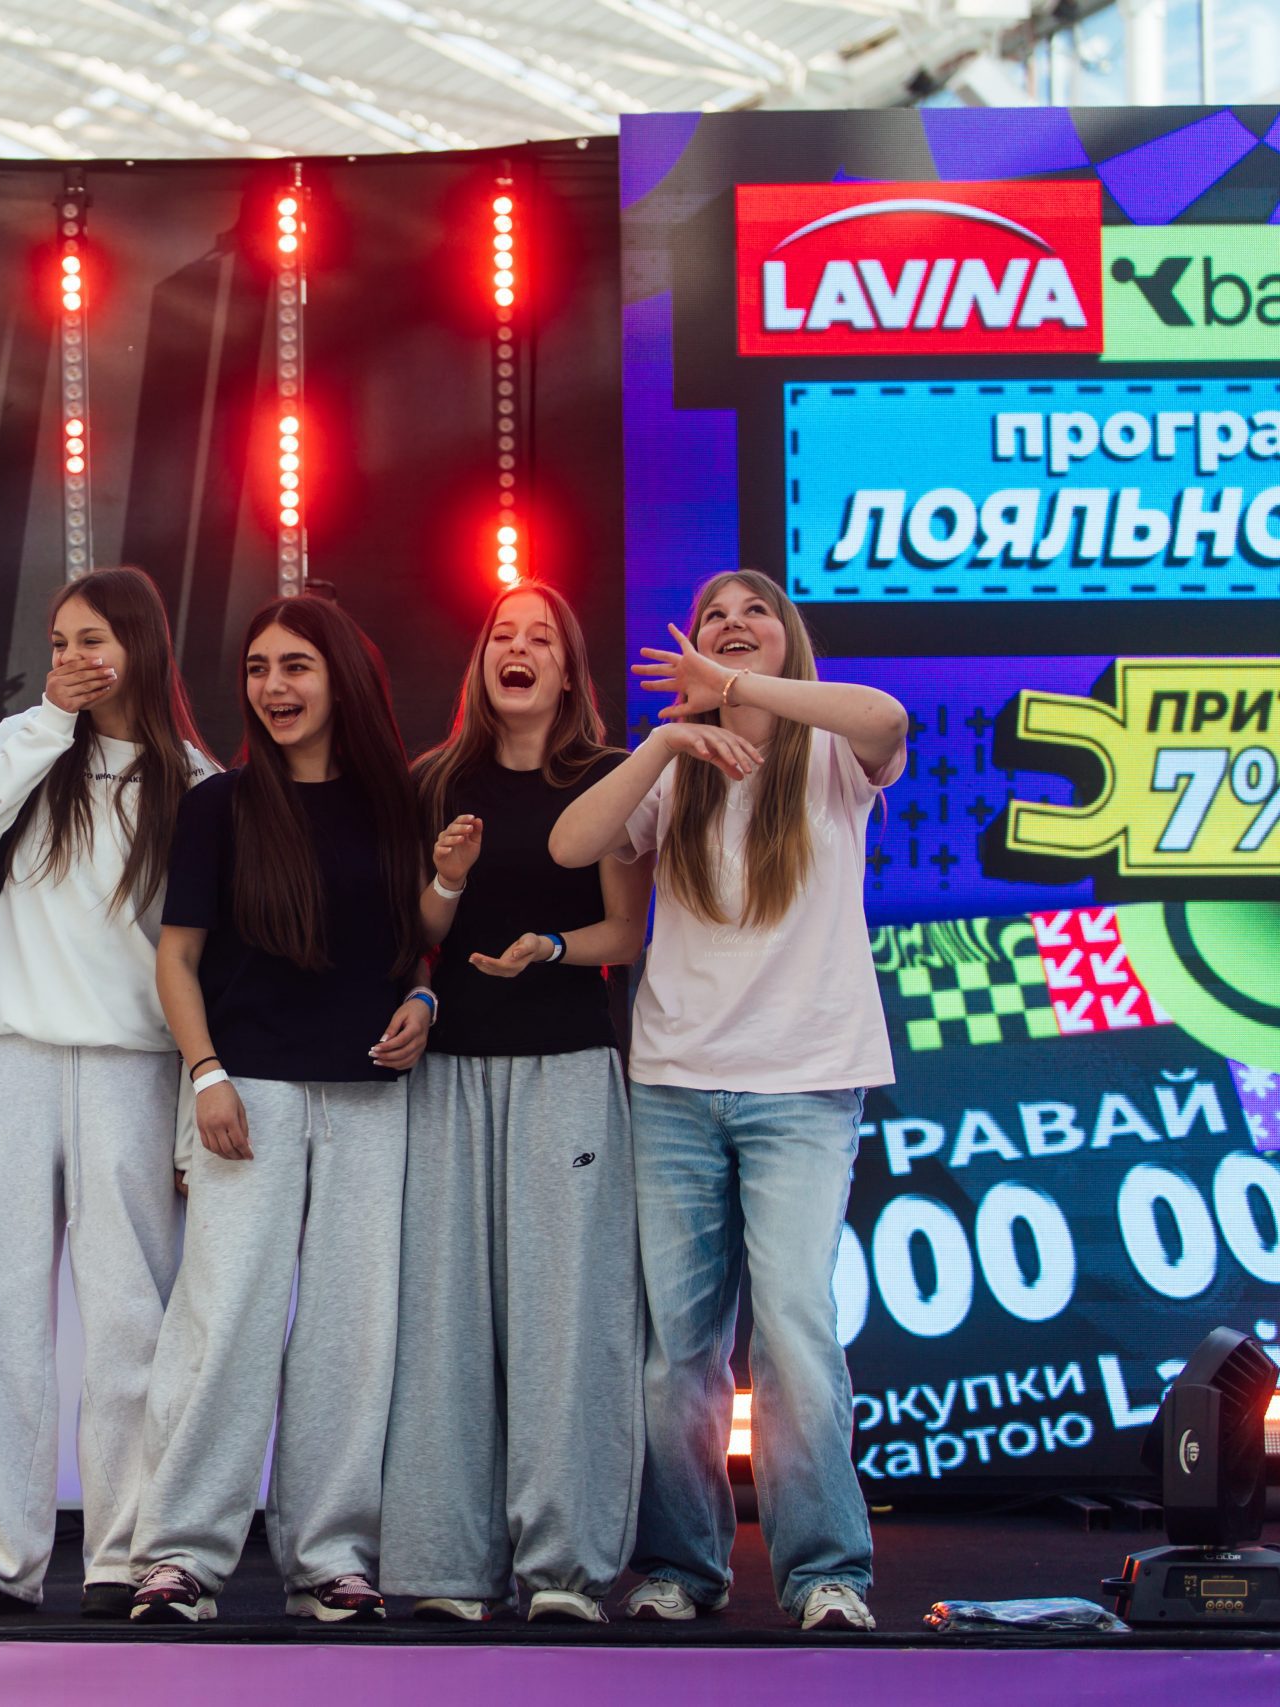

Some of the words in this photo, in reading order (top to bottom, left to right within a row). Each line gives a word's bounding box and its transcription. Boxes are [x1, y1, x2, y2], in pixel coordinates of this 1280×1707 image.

[761, 257, 1089, 331] LAVINA
[1147, 690, 1280, 733] ПРИ
[95, 772, 117, 780] WHAT
[118, 775, 144, 783] MAKE
[848, 1068, 1228, 1182] РАВАЙ
[851, 1361, 1086, 1431] окупки
